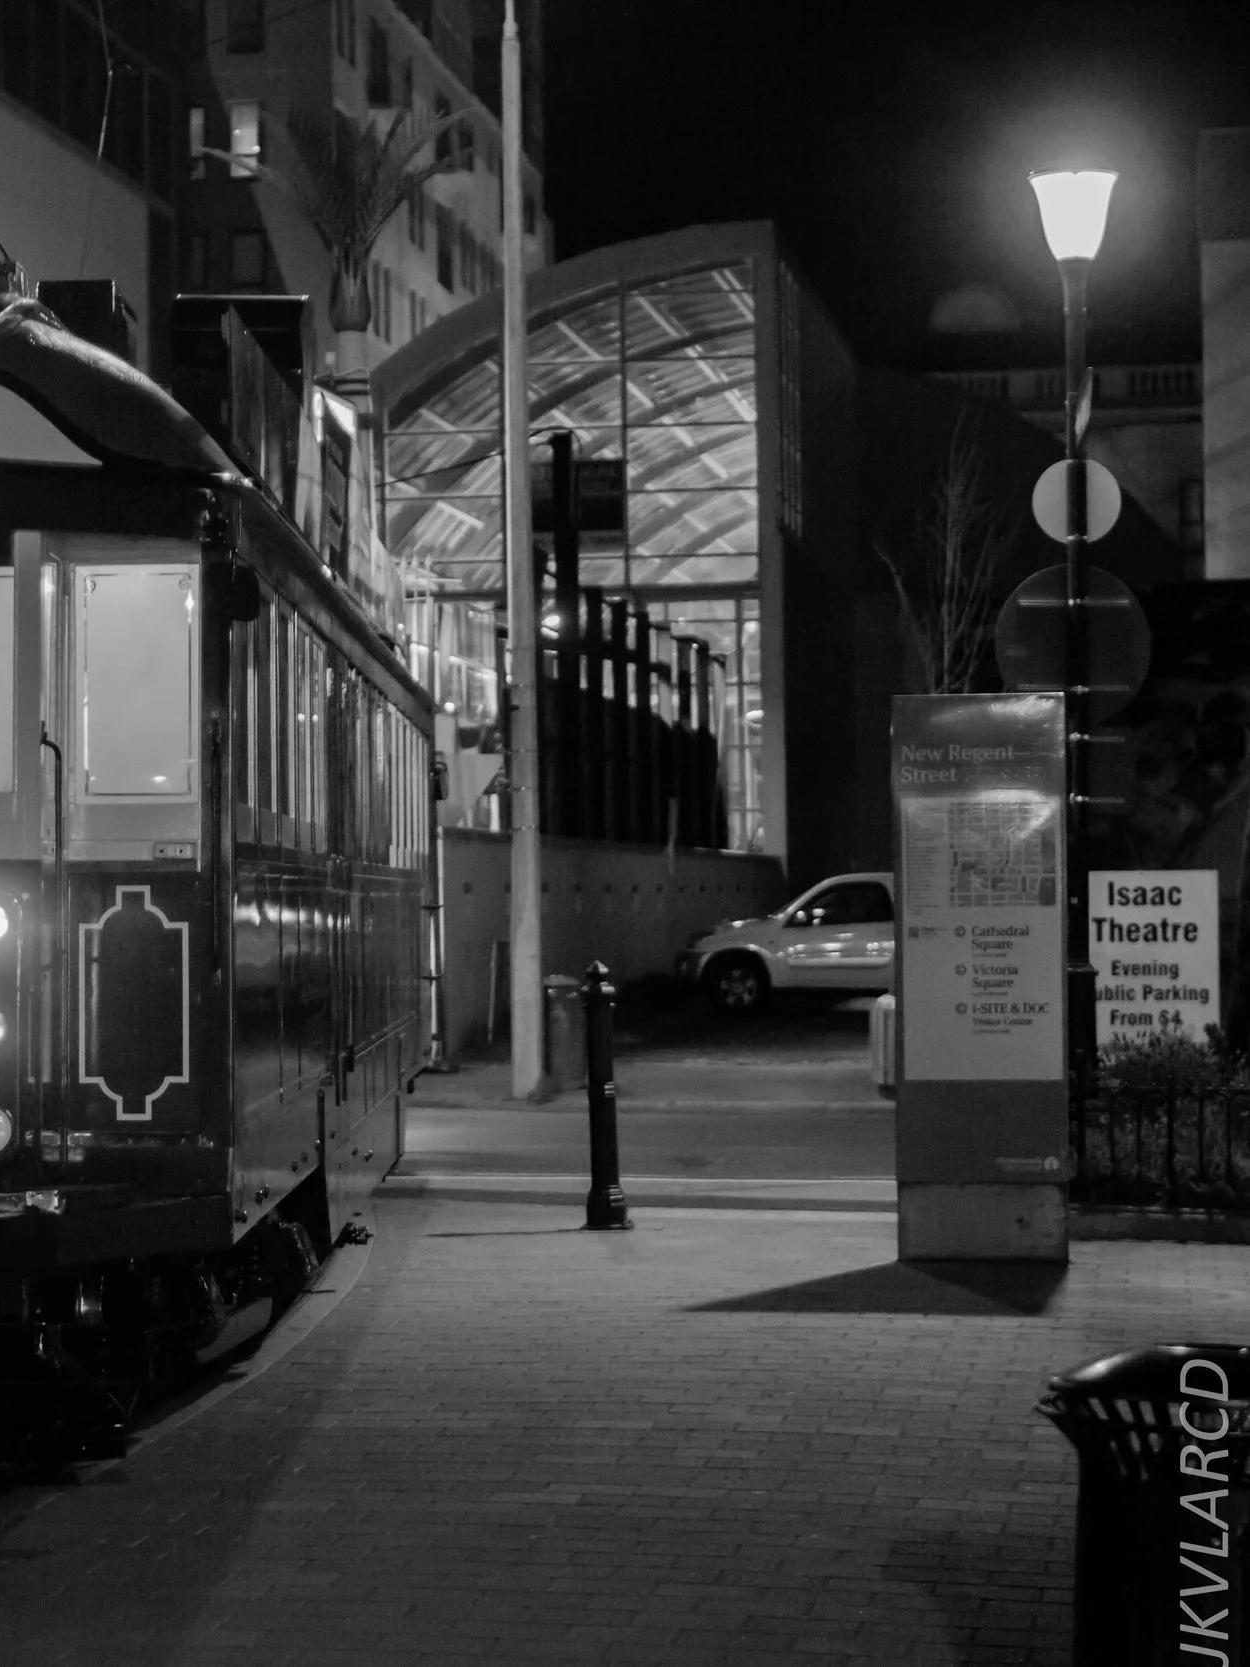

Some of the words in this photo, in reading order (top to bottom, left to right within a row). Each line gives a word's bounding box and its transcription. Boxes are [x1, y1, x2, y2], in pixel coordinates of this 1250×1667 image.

[900, 744, 943, 762] New
[949, 744, 1014, 764] Regent
[900, 765, 957, 784] Street
[1108, 881, 1182, 906] Isaac
[971, 925, 1030, 937] Cathedral
[1091, 917, 1198, 943] Theatre
[971, 938, 1014, 951] Square
[972, 964, 1019, 976] Victoria
[1111, 960, 1179, 979] Evening
[972, 977, 1014, 990] Square
[1095, 984, 1135, 1002] ublic
[1142, 984, 1210, 1004] Parking
[1023, 1002, 1050, 1014] DOC
[1110, 1009, 1153, 1026] From
